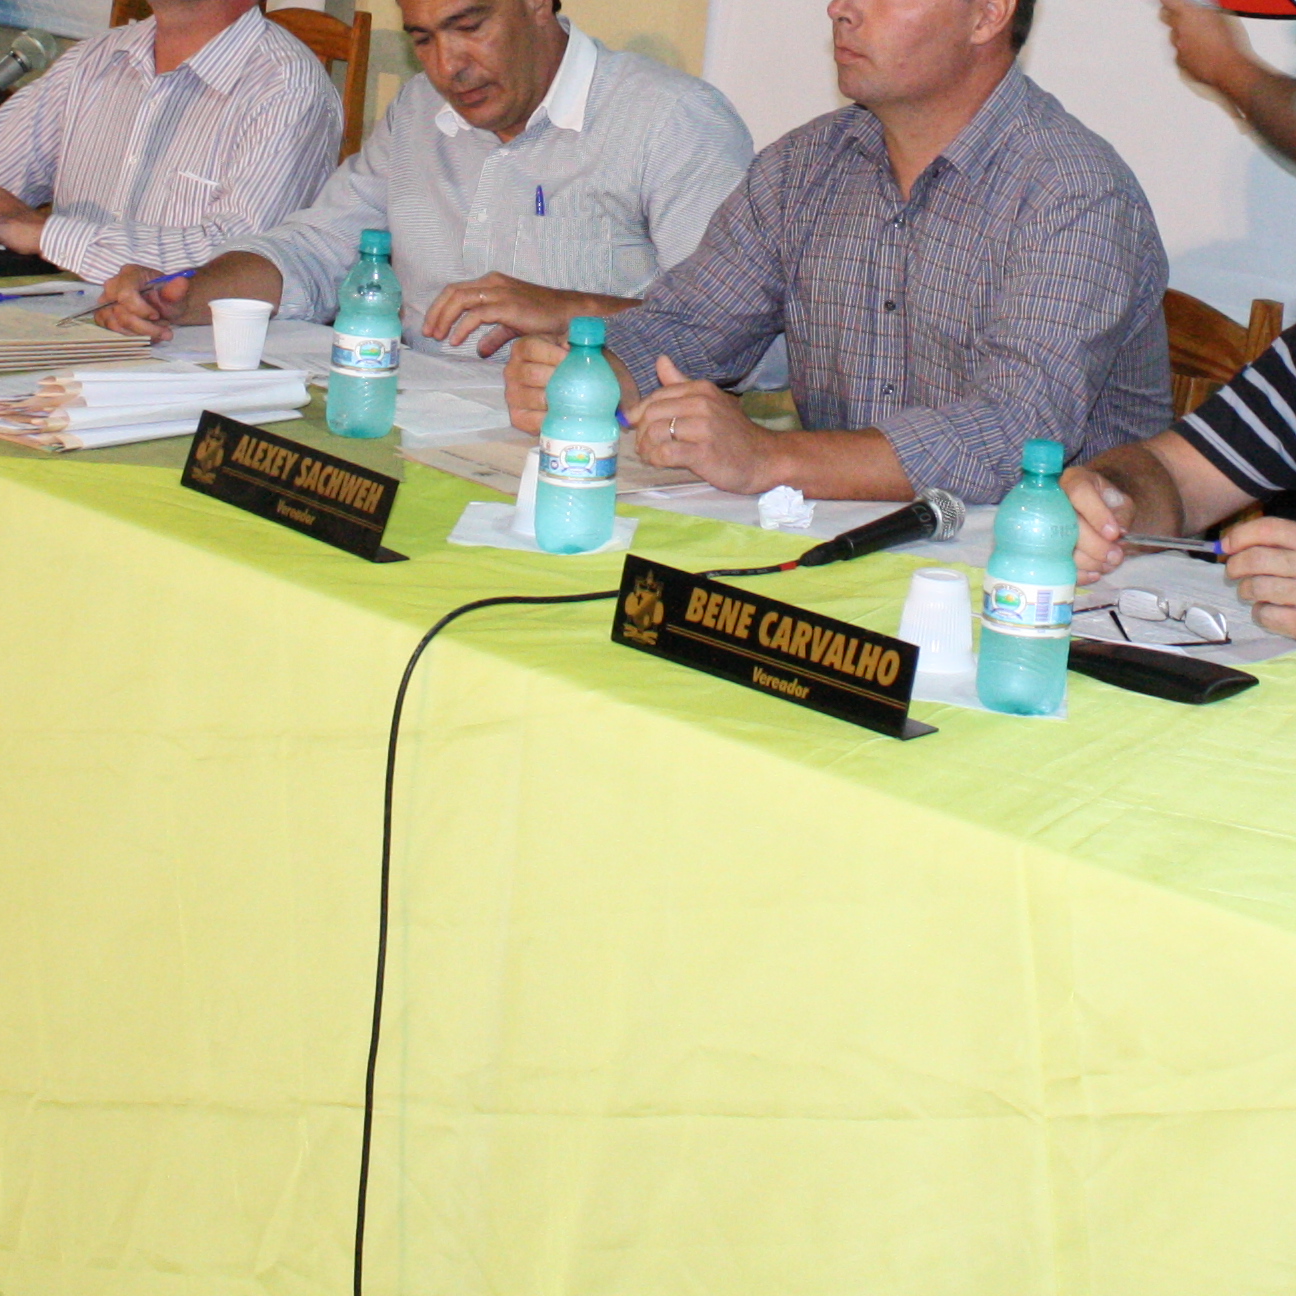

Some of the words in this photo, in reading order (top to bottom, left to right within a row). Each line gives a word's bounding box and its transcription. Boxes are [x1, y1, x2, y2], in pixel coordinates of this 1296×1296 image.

[231, 434, 300, 481] ALEXEY
[294, 457, 385, 514] SACHWEH
[685, 587, 757, 639] BENE
[758, 611, 900, 687] CARVALHO
[752, 666, 810, 700] Vereador
